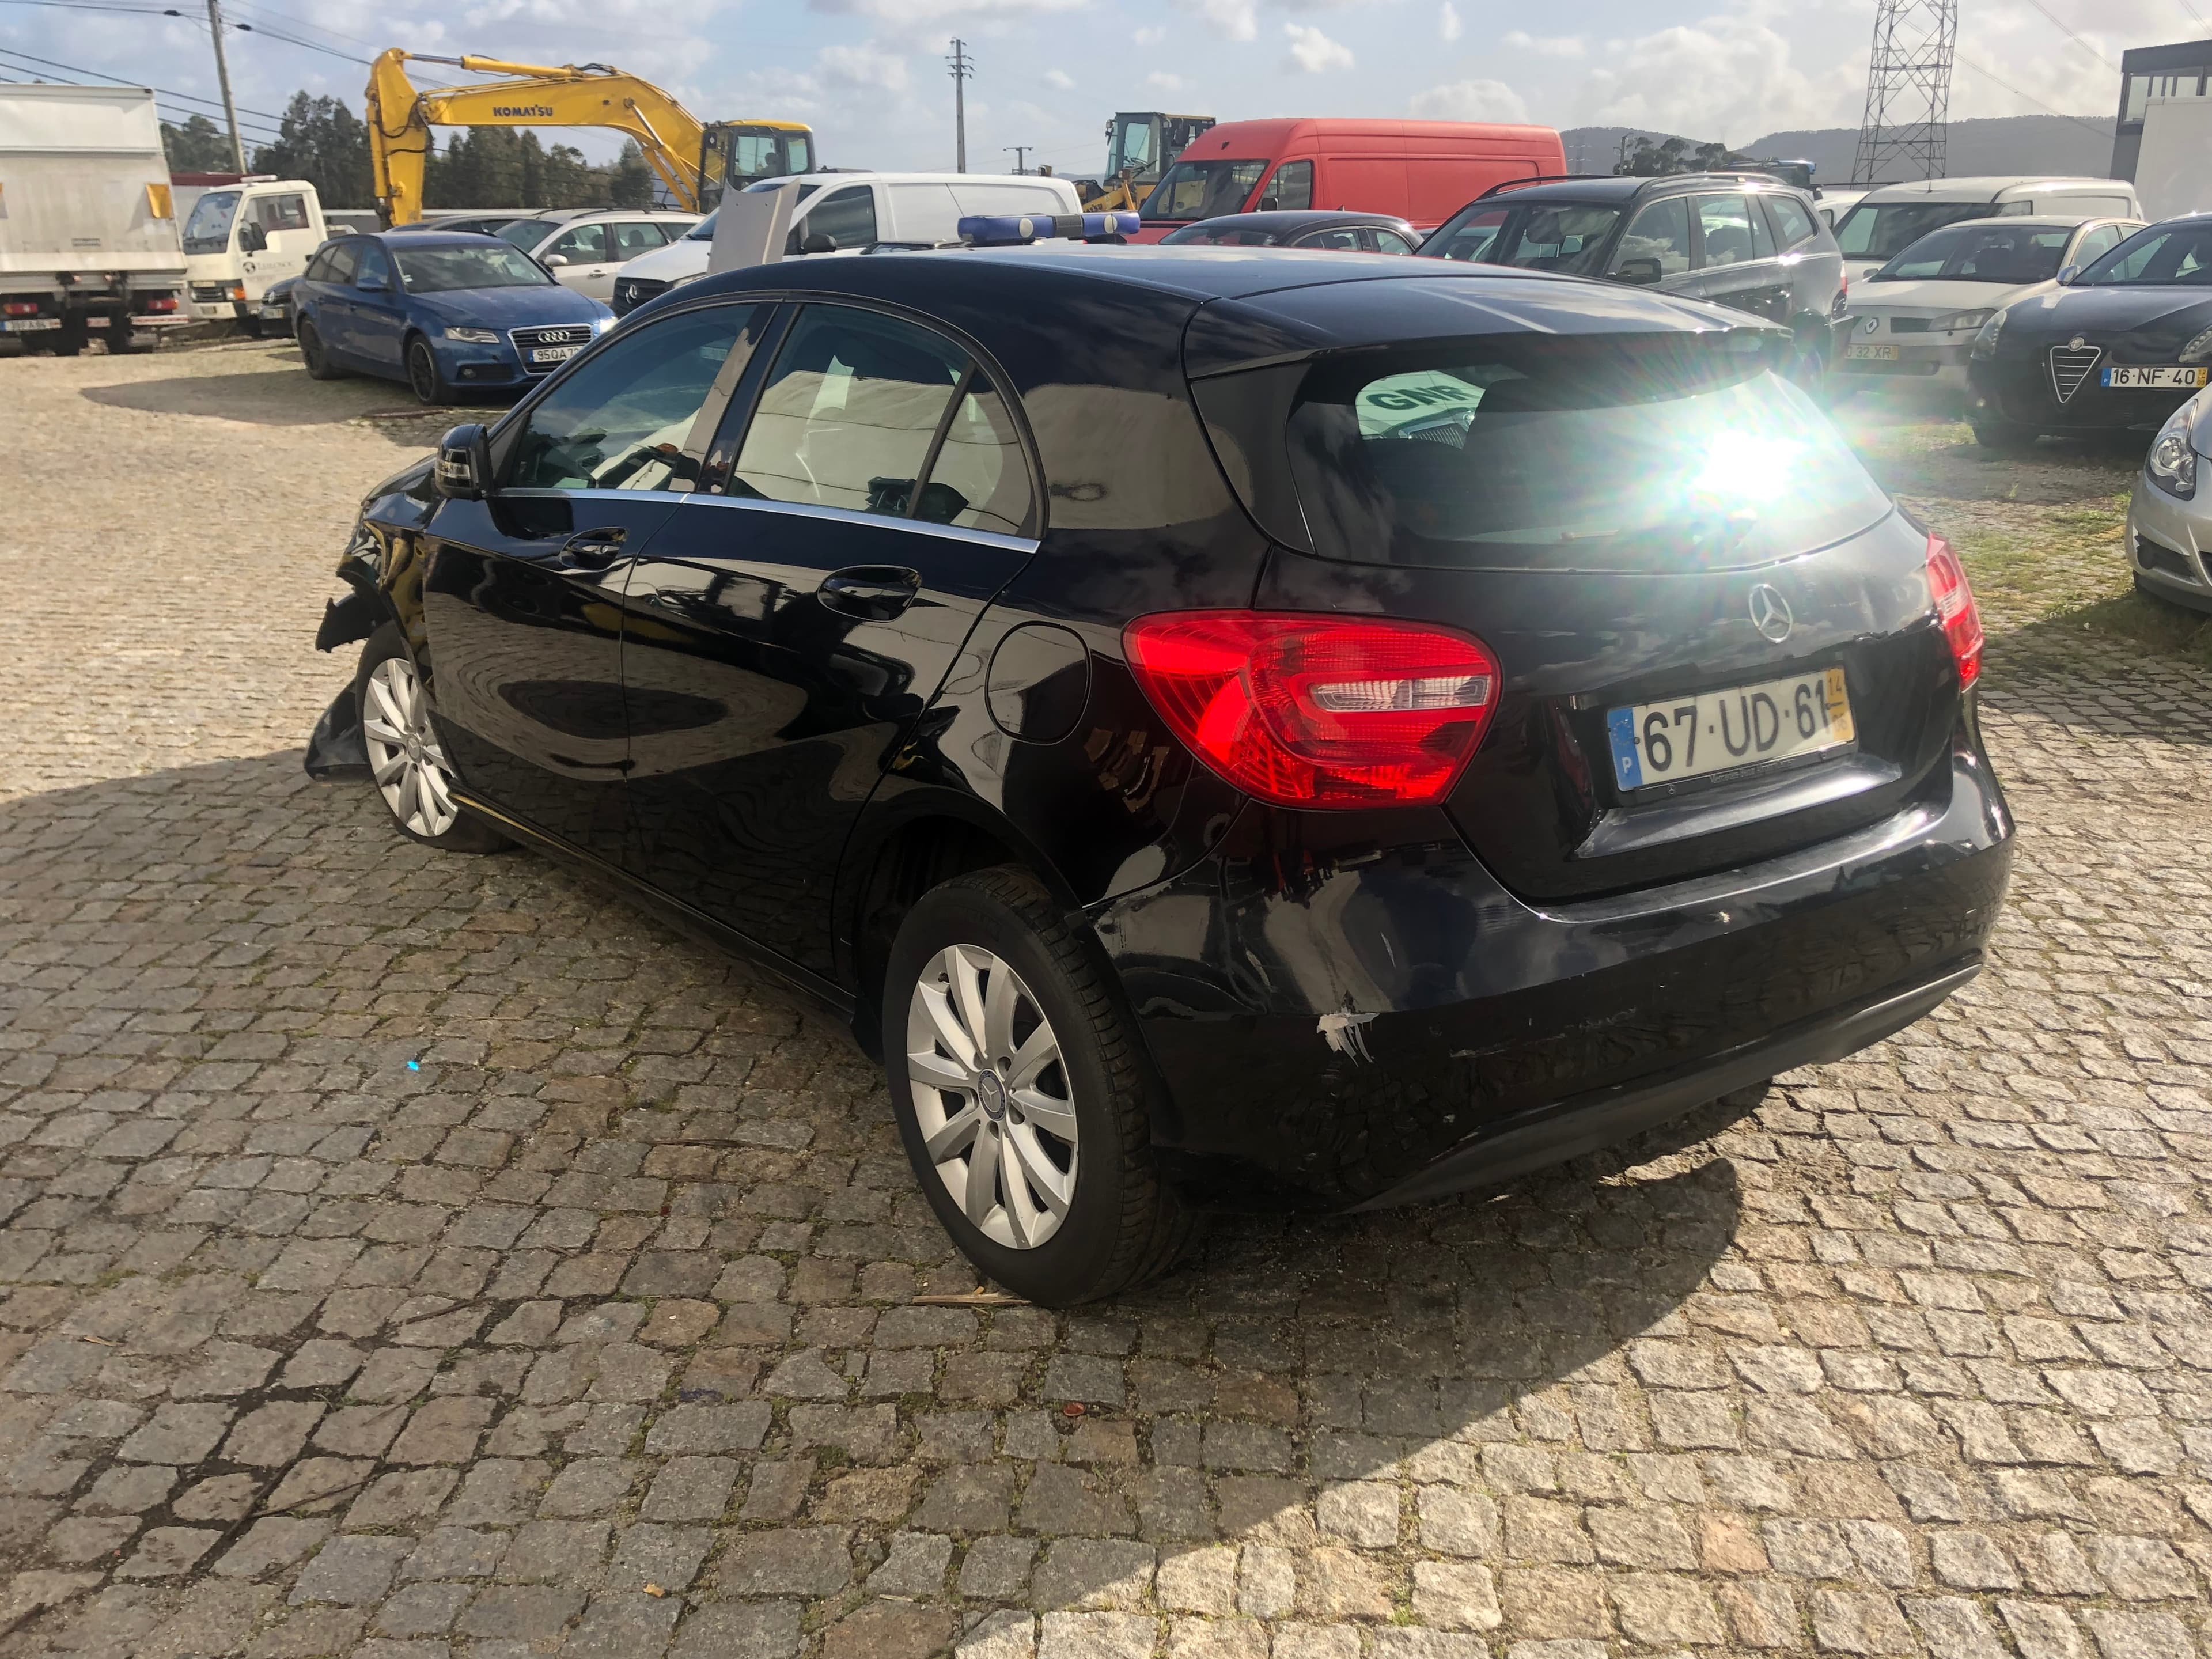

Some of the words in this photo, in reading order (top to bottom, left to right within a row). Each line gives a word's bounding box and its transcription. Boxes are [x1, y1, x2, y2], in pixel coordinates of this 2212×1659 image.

[493, 105, 553, 116] KOMATSU
[1366, 385, 1481, 410] GNR
[1622, 756, 1632, 774] P
